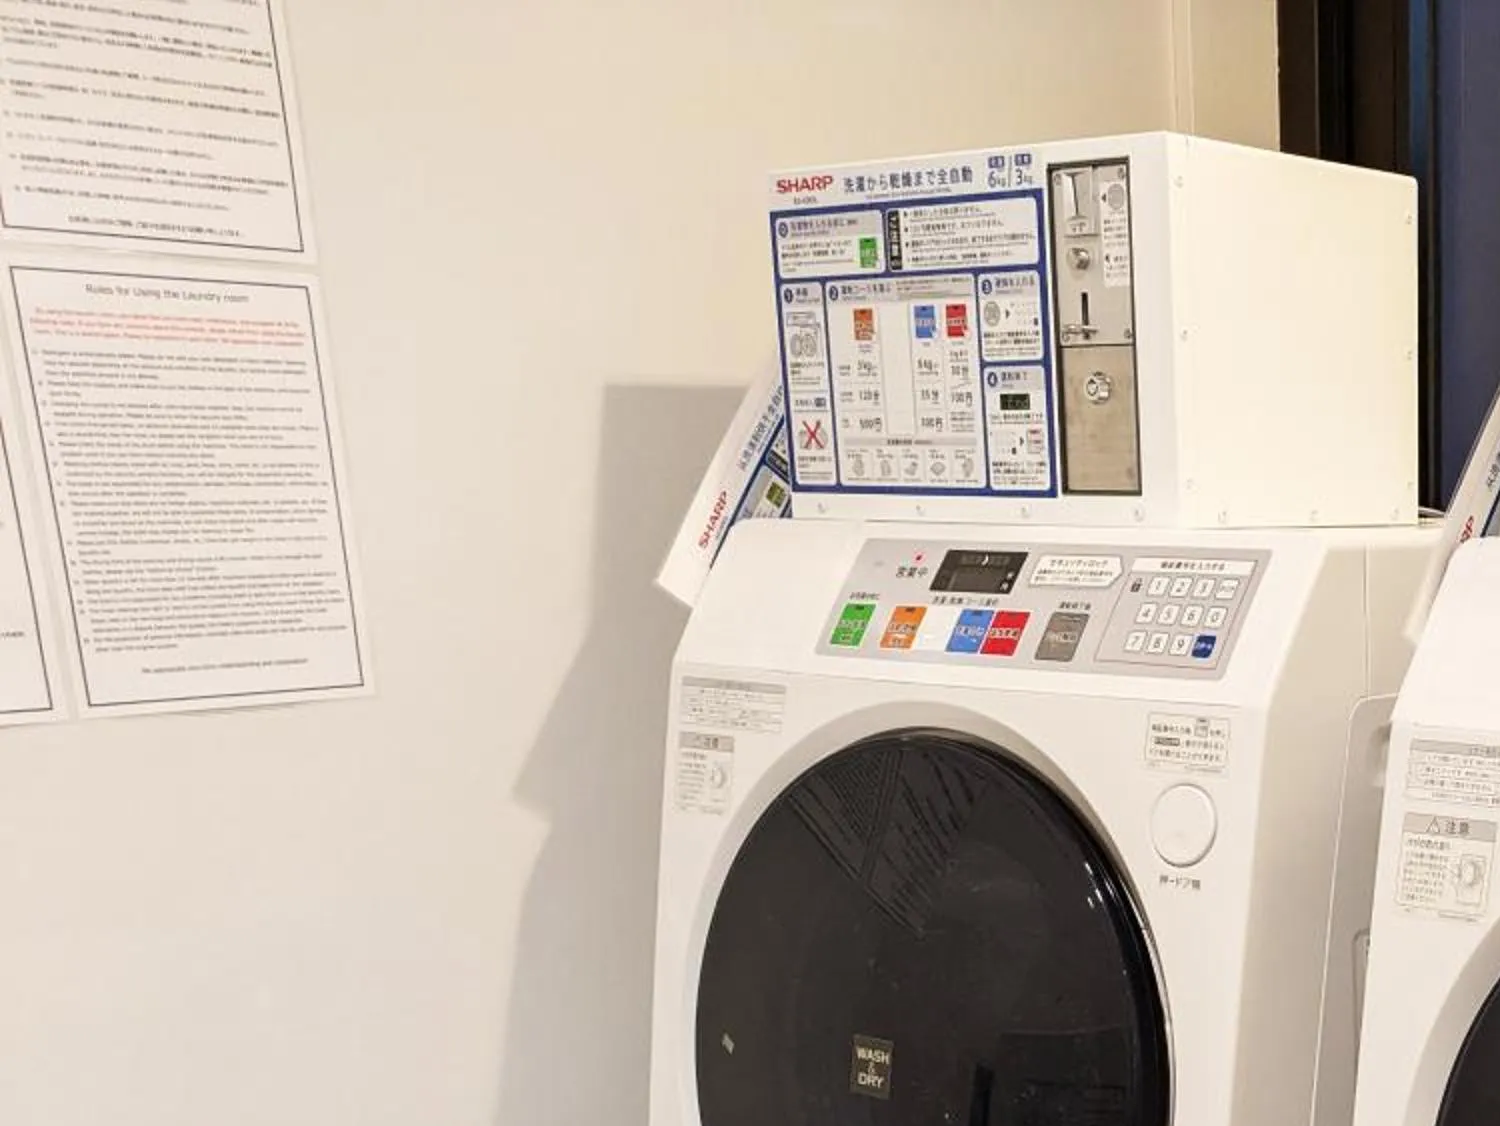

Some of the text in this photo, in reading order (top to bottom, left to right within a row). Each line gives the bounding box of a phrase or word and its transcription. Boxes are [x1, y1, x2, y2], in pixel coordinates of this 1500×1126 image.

[776, 175, 833, 194] SHARP
[85, 283, 113, 296] Rules
[117, 285, 130, 296] for
[133, 287, 161, 300] Using
[163, 288, 180, 299] the
[183, 290, 221, 304] Laundry
[856, 1046, 890, 1065] WASH
[857, 1071, 885, 1089] DRY
